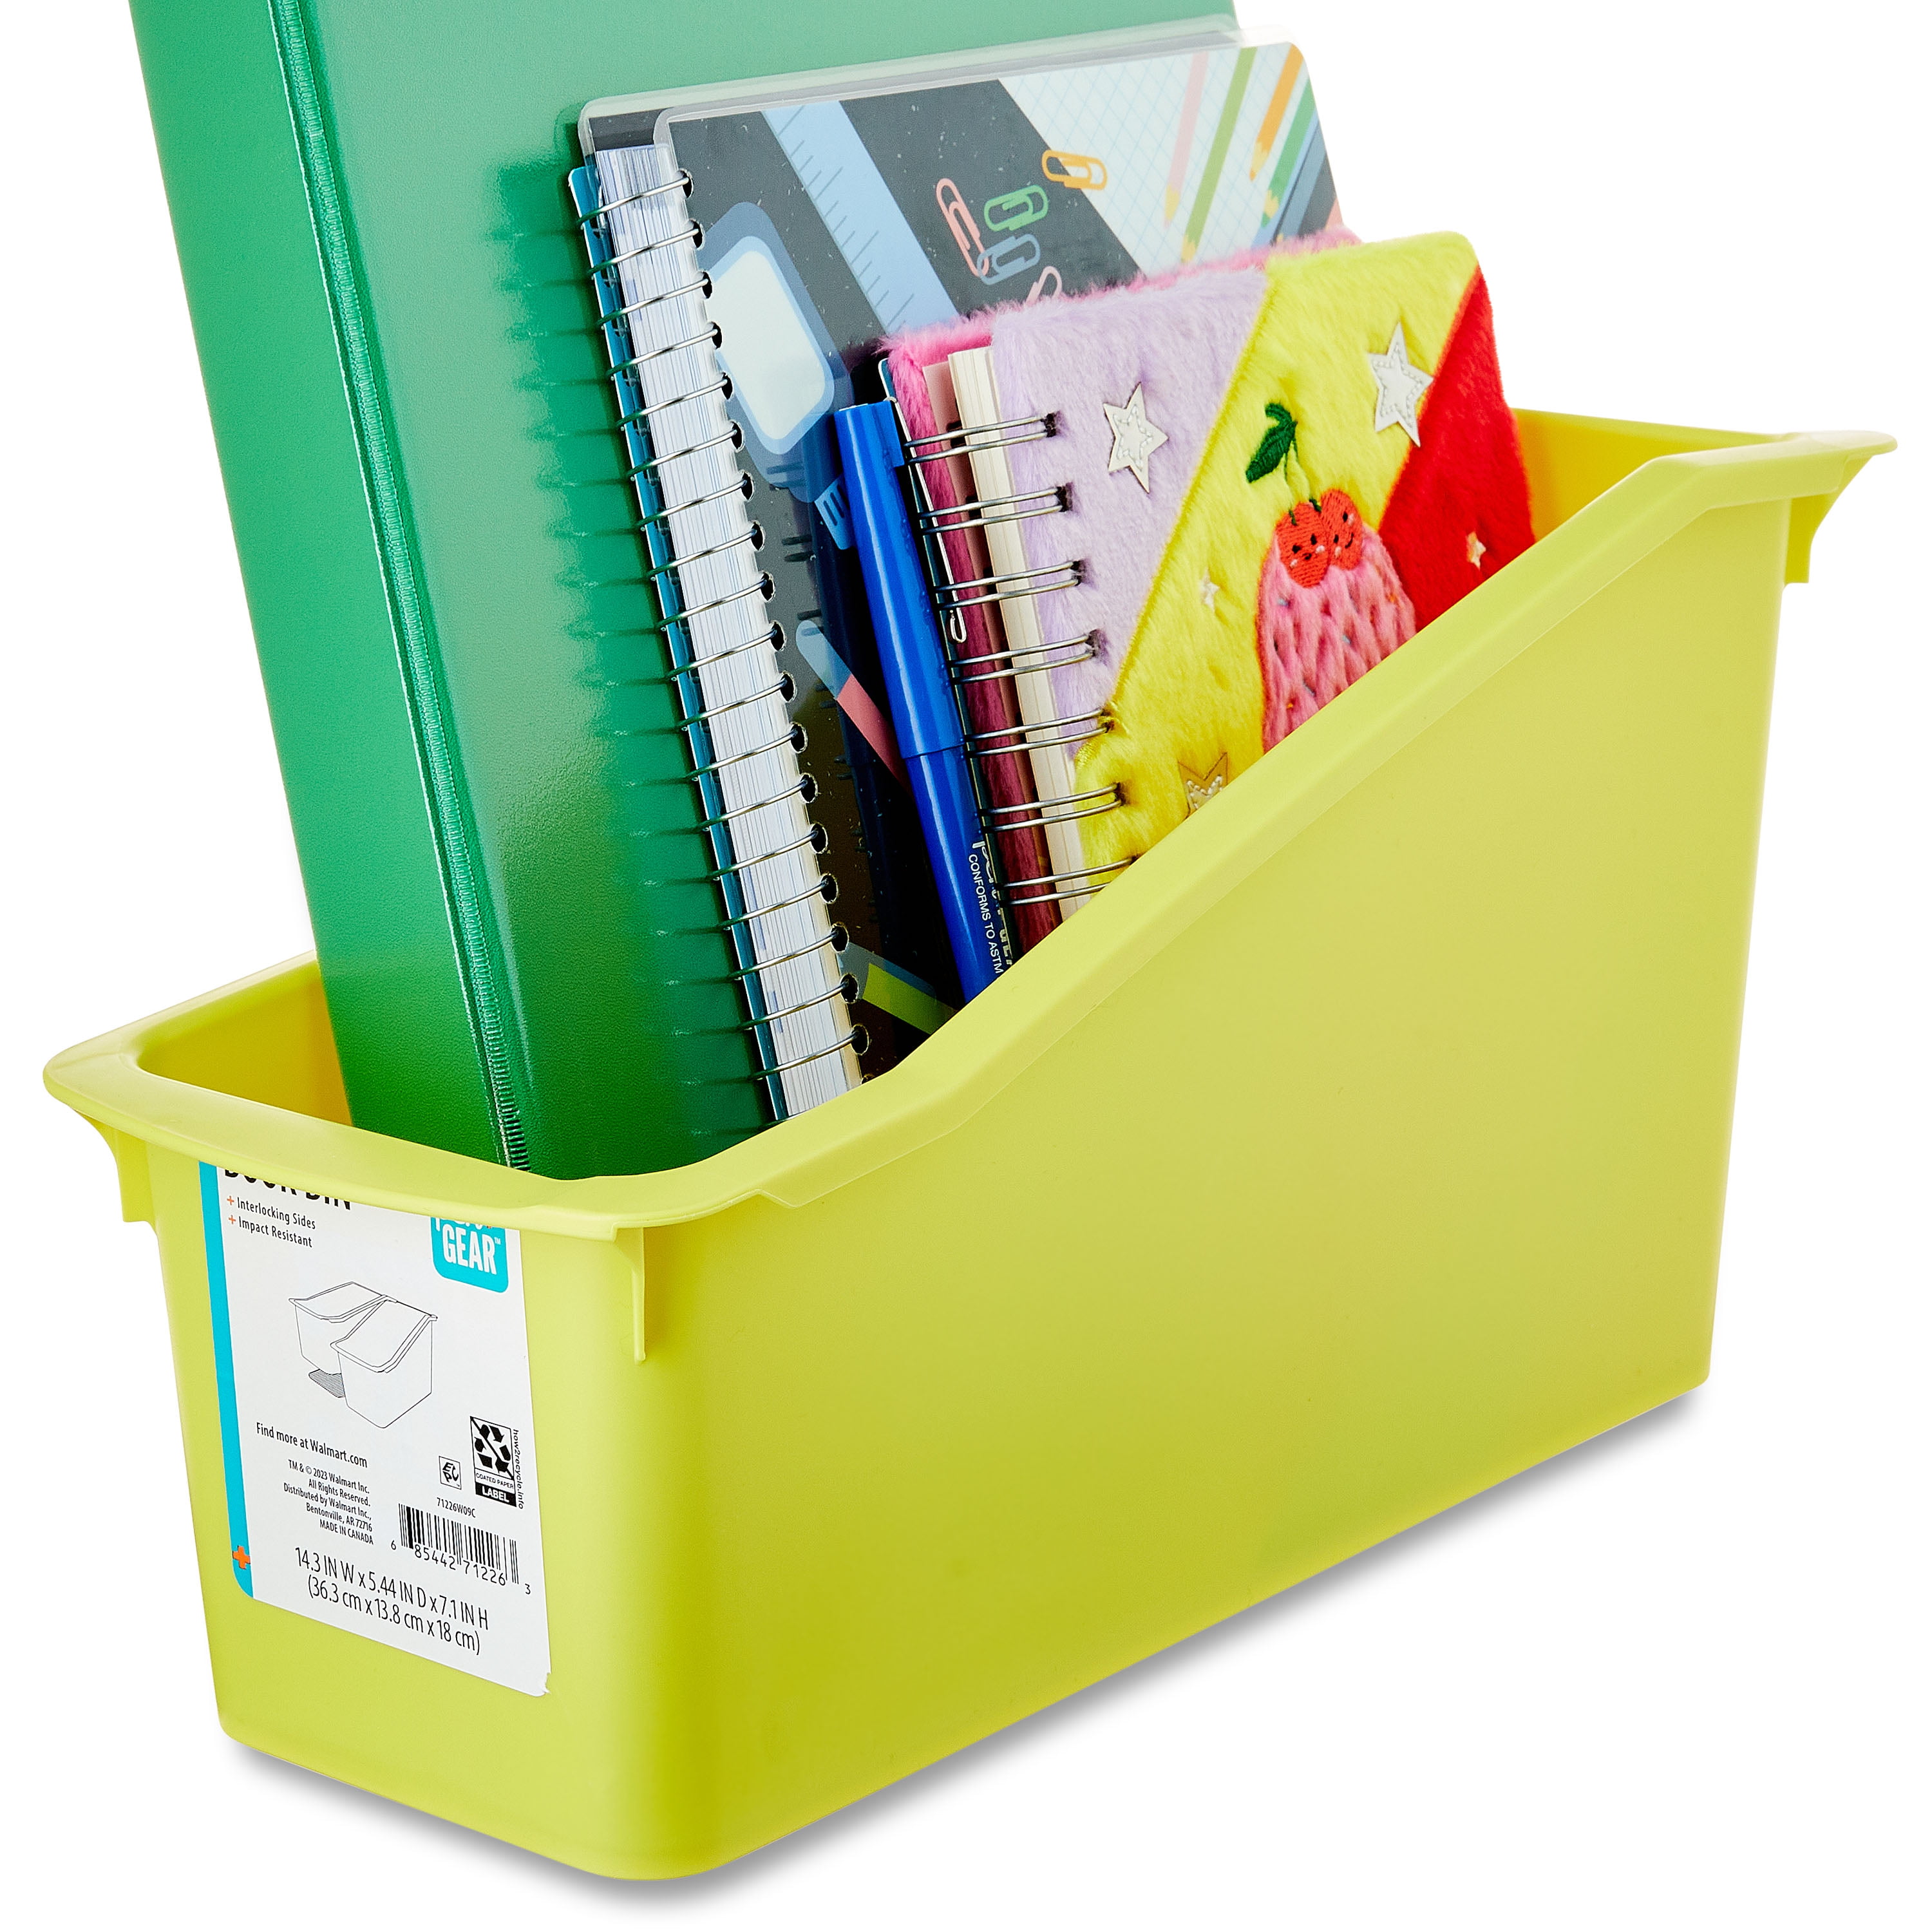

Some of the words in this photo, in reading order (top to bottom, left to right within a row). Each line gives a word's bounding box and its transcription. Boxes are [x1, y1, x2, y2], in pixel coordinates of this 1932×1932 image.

[968, 854, 991, 921] CONFORMS
[984, 922, 996, 939] TO
[988, 941, 1004, 974] ASTM
[237, 1197, 290, 1225] Interlocking
[292, 1213, 316, 1229] Sides
[239, 1216, 269, 1236] Impact
[272, 1226, 312, 1248] Resistant
[256, 1422, 274, 1438] Find
[276, 1431, 298, 1446] more
[300, 1438, 309, 1450] at
[310, 1439, 368, 1468] Walmart.com
[289, 1459, 298, 1471] TM
[299, 1463, 305, 1473] &
[313, 1468, 328, 1480] 2023
[328, 1472, 357, 1490] Walmart
[358, 1481, 370, 1494] Inc.
[308, 1479, 317, 1489] All
[318, 1481, 338, 1496] Rights
[339, 1489, 370, 1506] Reserved.
[475, 1473, 496, 1484] COATED
[497, 1479, 514, 1489] PAPER
[284, 1482, 318, 1502] Distributed
[320, 1494, 328, 1506] by
[328, 1497, 357, 1515] Walmart
[358, 1506, 372, 1520] Inc.,
[437, 1497, 476, 1519] 71226W09C
[482, 1486, 510, 1502] LABEL
[306, 1502, 345, 1524] Bentonville,
[346, 1515, 354, 1527] AR
[319, 1519, 338, 1533] MADE
[339, 1525, 346, 1536] IN
[348, 1528, 374, 1545] CANADA
[295, 1547, 321, 1573] 14.3
[324, 1555, 337, 1578] IN
[340, 1560, 354, 1584] W
[400, 1580, 413, 1605] IN
[417, 1586, 426, 1607] D
[460, 1601, 475, 1626] IN
[478, 1607, 489, 1631] H
[308, 1574, 339, 1604] (36.3
[343, 1591, 362, 1612] cm
[404, 1611, 424, 1633] cm
[437, 1620, 451, 1642] 18
[455, 1630, 480, 1655] cm)
